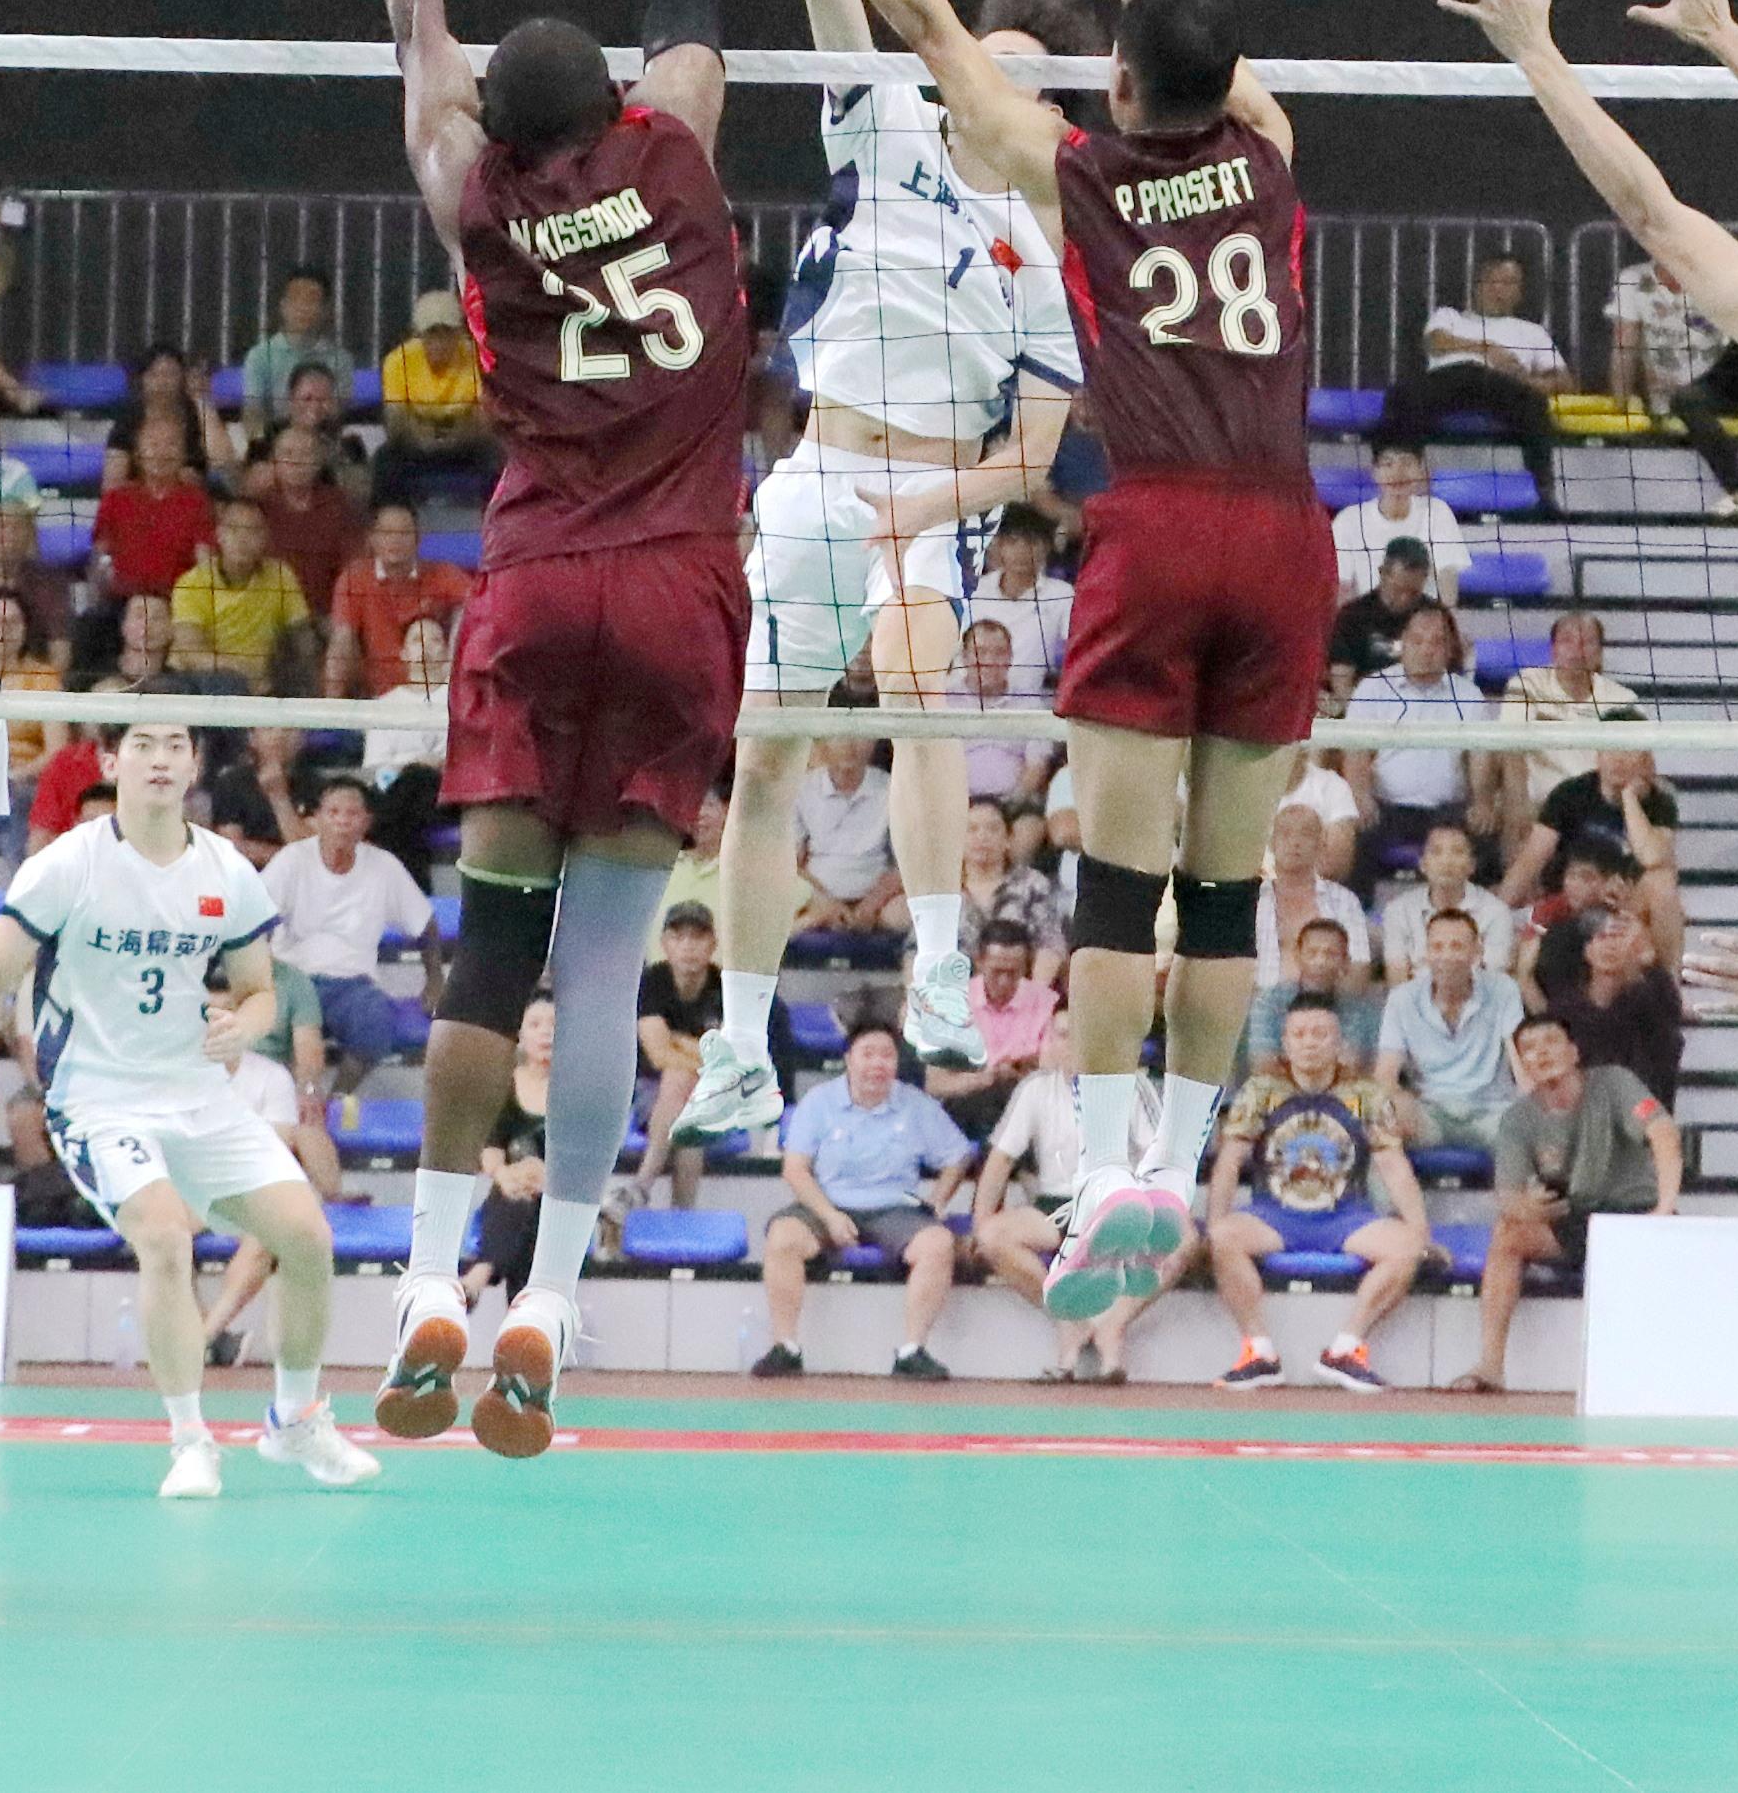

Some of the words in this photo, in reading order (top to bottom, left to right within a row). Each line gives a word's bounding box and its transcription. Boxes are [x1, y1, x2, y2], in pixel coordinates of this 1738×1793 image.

[1114, 156, 1255, 226] P.PRASERT
[541, 241, 705, 382] 25
[1128, 232, 1282, 356] 28
[138, 966, 166, 1016] 3
[118, 1134, 152, 1166] 3
